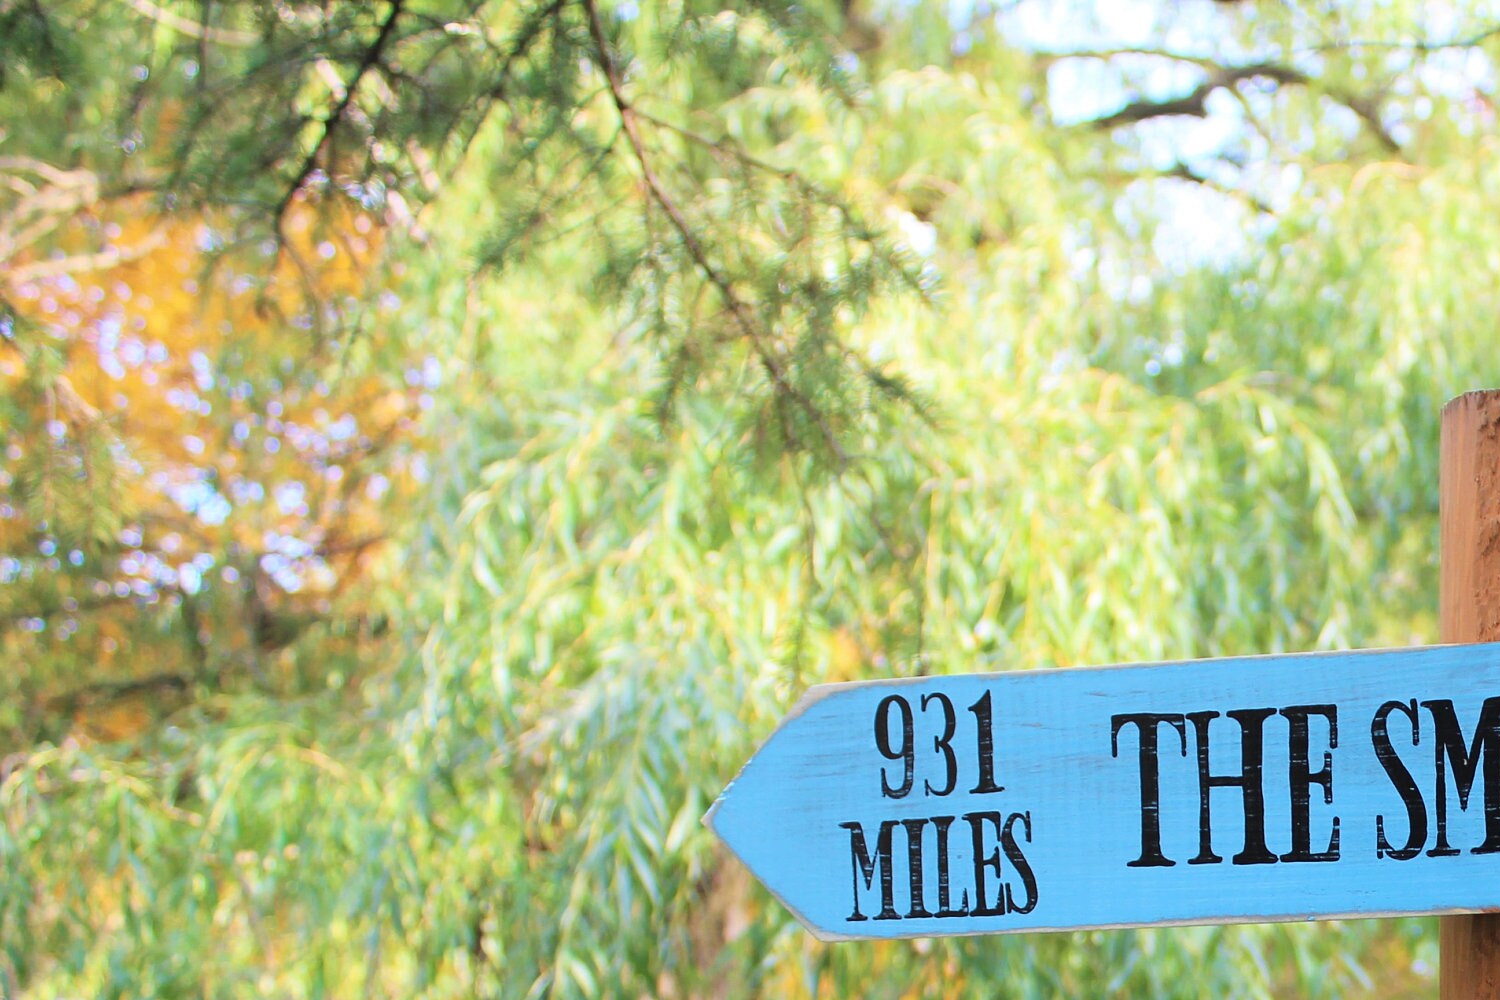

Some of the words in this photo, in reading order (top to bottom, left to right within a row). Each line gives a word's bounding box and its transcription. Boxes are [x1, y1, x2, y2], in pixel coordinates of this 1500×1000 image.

[874, 690, 1005, 800] 931
[1110, 703, 1342, 868] THE
[838, 811, 1039, 922] MILES
